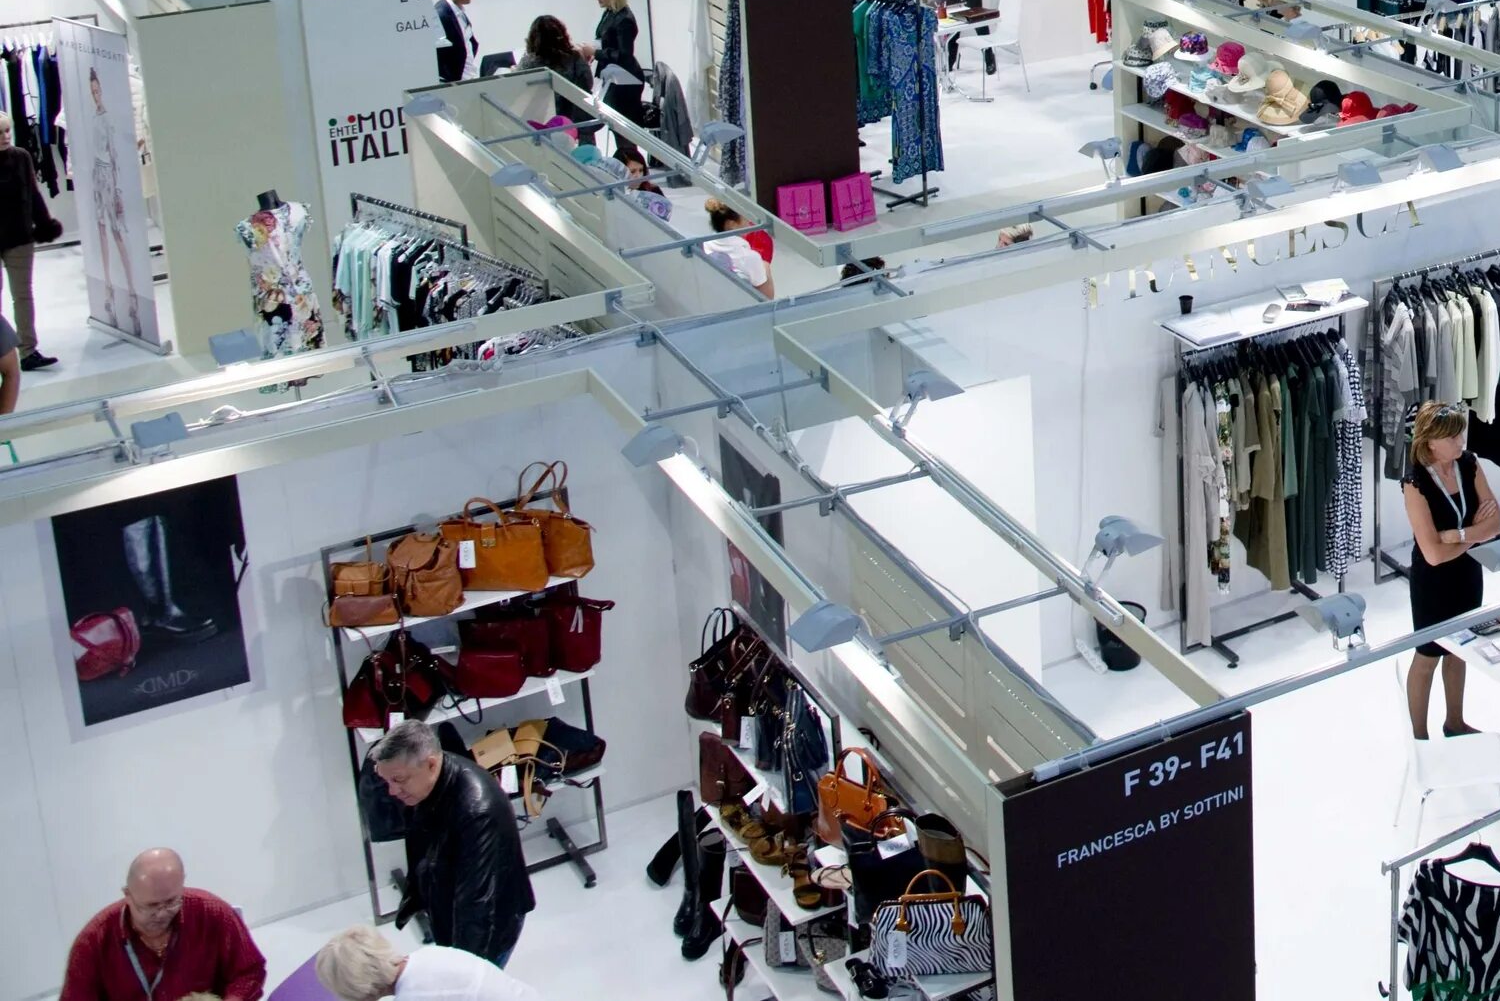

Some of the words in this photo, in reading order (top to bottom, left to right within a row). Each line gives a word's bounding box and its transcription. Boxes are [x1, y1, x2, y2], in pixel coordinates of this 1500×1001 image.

[396, 15, 430, 33] GALÀ
[329, 123, 358, 139] ENTE
[330, 127, 409, 167] ITALI
[1123, 768, 1141, 797] F
[1149, 755, 1192, 787] 39-
[1200, 731, 1244, 769] F41
[1057, 819, 1156, 869] FRANCESCA
[1159, 808, 1180, 830] BY
[1183, 785, 1244, 820] SOTTINI
